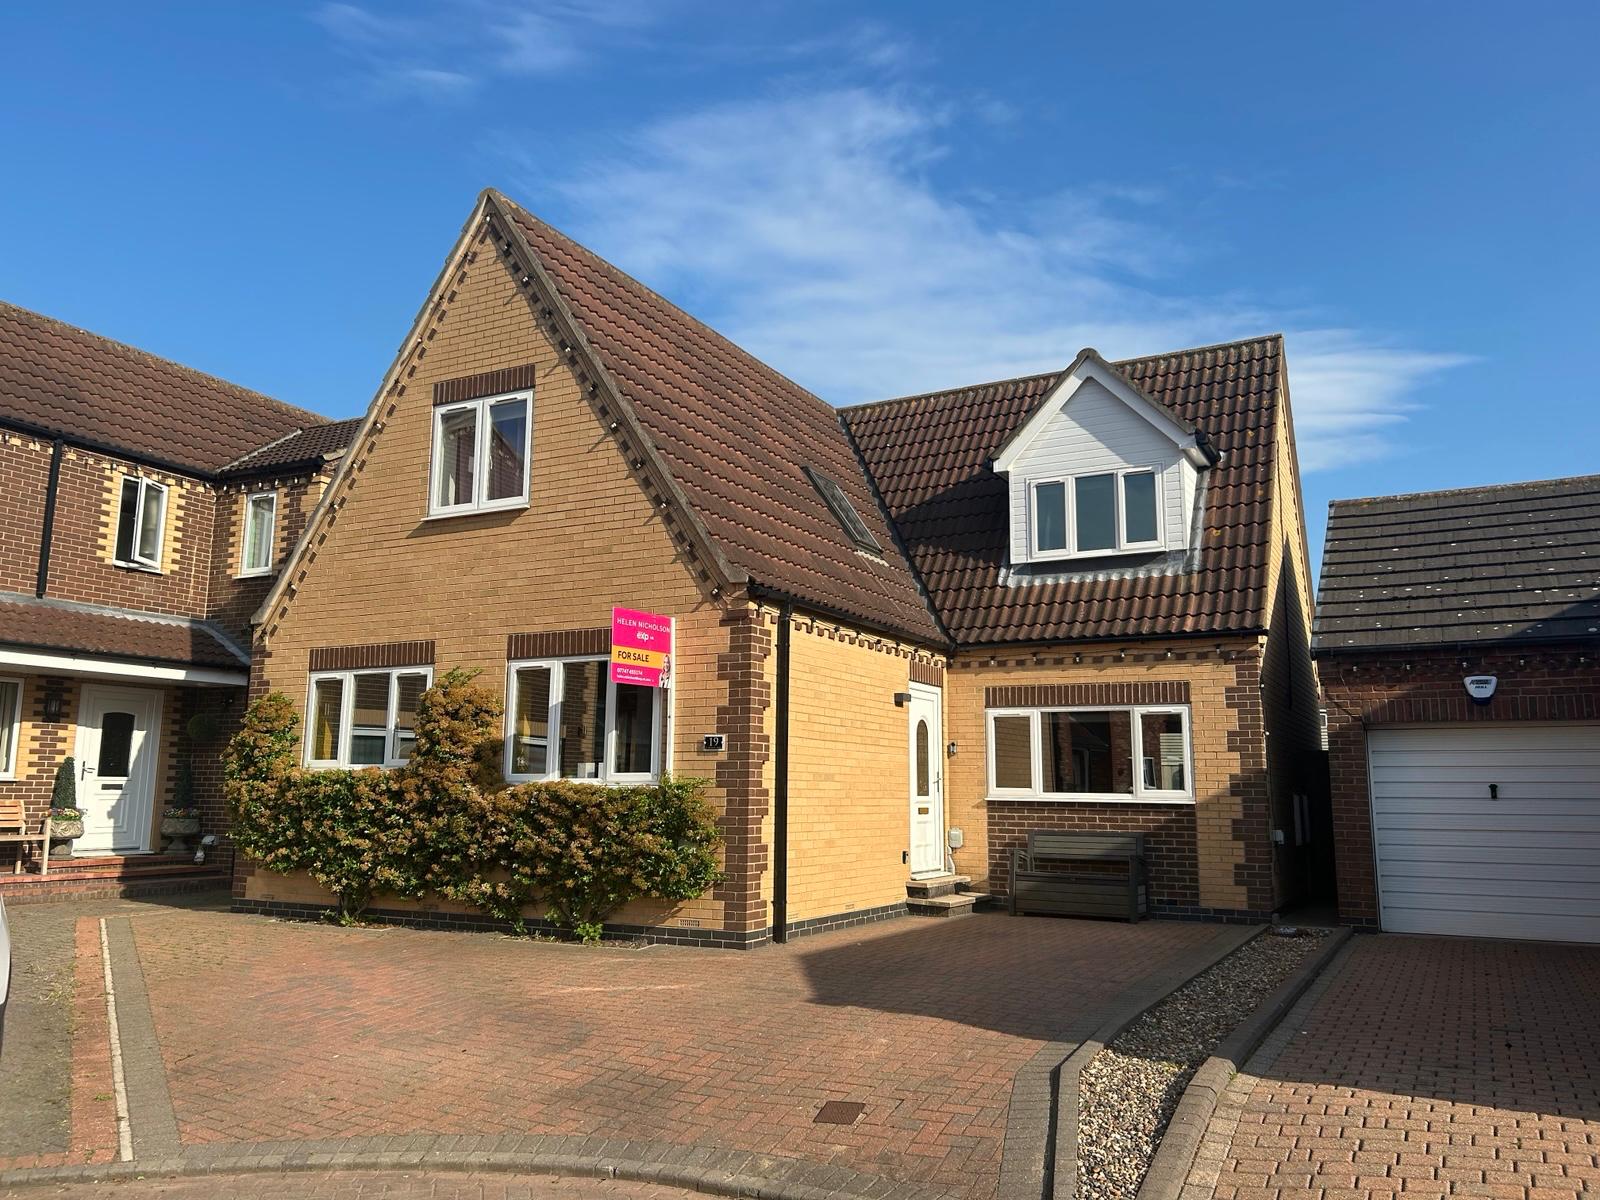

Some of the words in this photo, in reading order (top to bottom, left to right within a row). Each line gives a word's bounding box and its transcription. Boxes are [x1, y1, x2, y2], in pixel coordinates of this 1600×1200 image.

[617, 618, 636, 626] HELEN
[638, 621, 670, 632] NICHOLSON
[617, 650, 631, 660] FOR
[632, 652, 650, 662] SALE
[709, 737, 719, 746] 19
